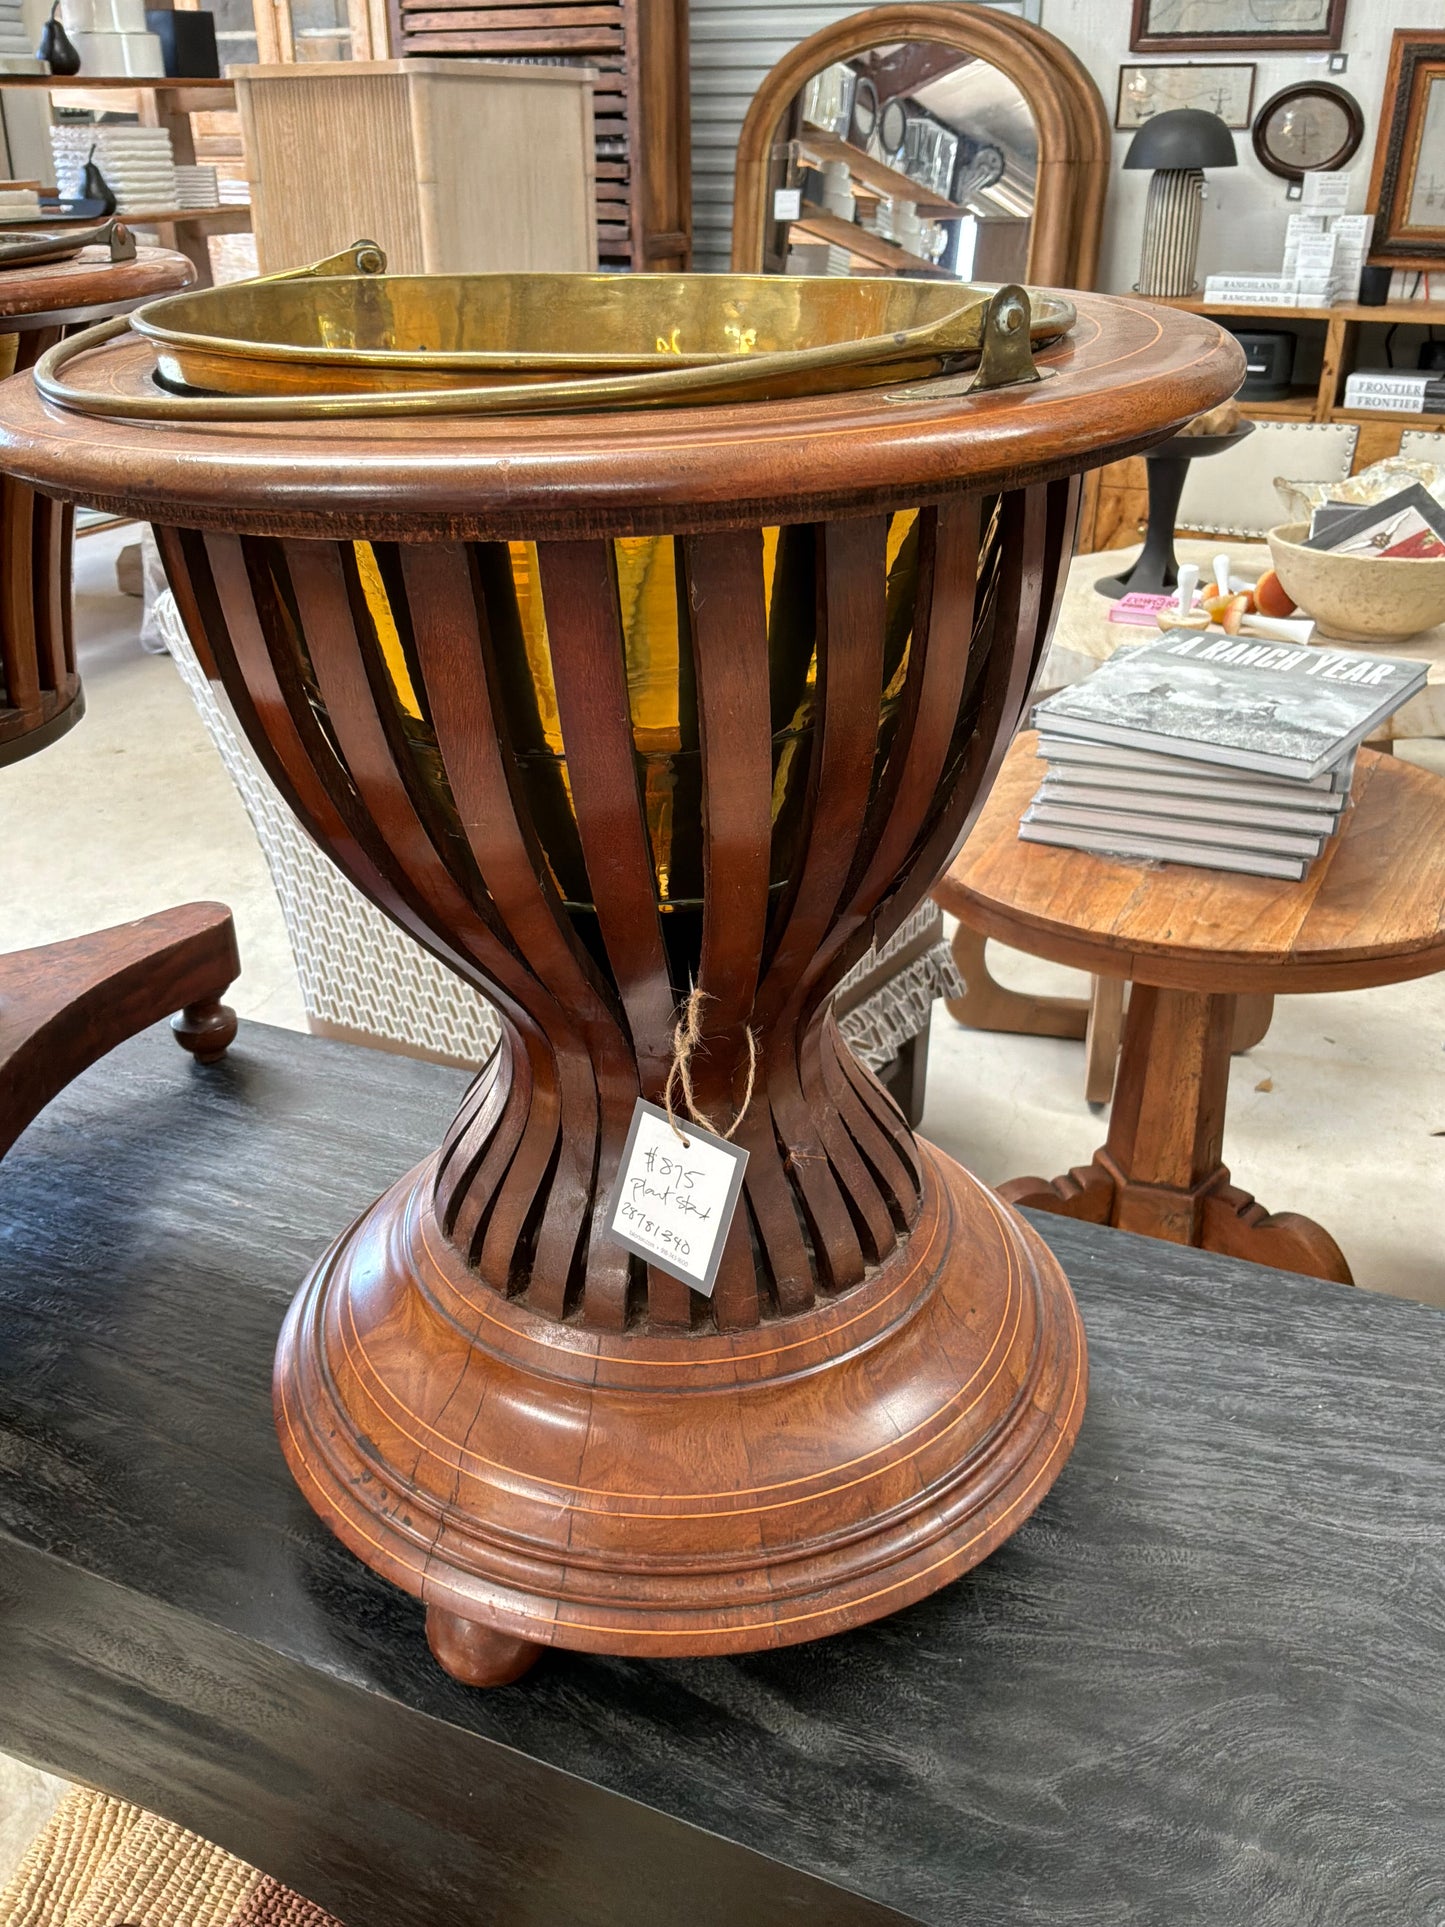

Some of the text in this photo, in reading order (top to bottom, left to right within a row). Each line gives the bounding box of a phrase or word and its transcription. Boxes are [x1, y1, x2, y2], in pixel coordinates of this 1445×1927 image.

[1221, 293, 1279, 303] RANCHLAND
[1359, 381, 1421, 396] FRONTIER
[1357, 396, 1420, 409] FRONTIER
[1167, 636, 1204, 654] A
[1196, 639, 1306, 671] RANCH
[1306, 654, 1396, 685] YEAR
[621, 1202, 690, 1255] 28781340
